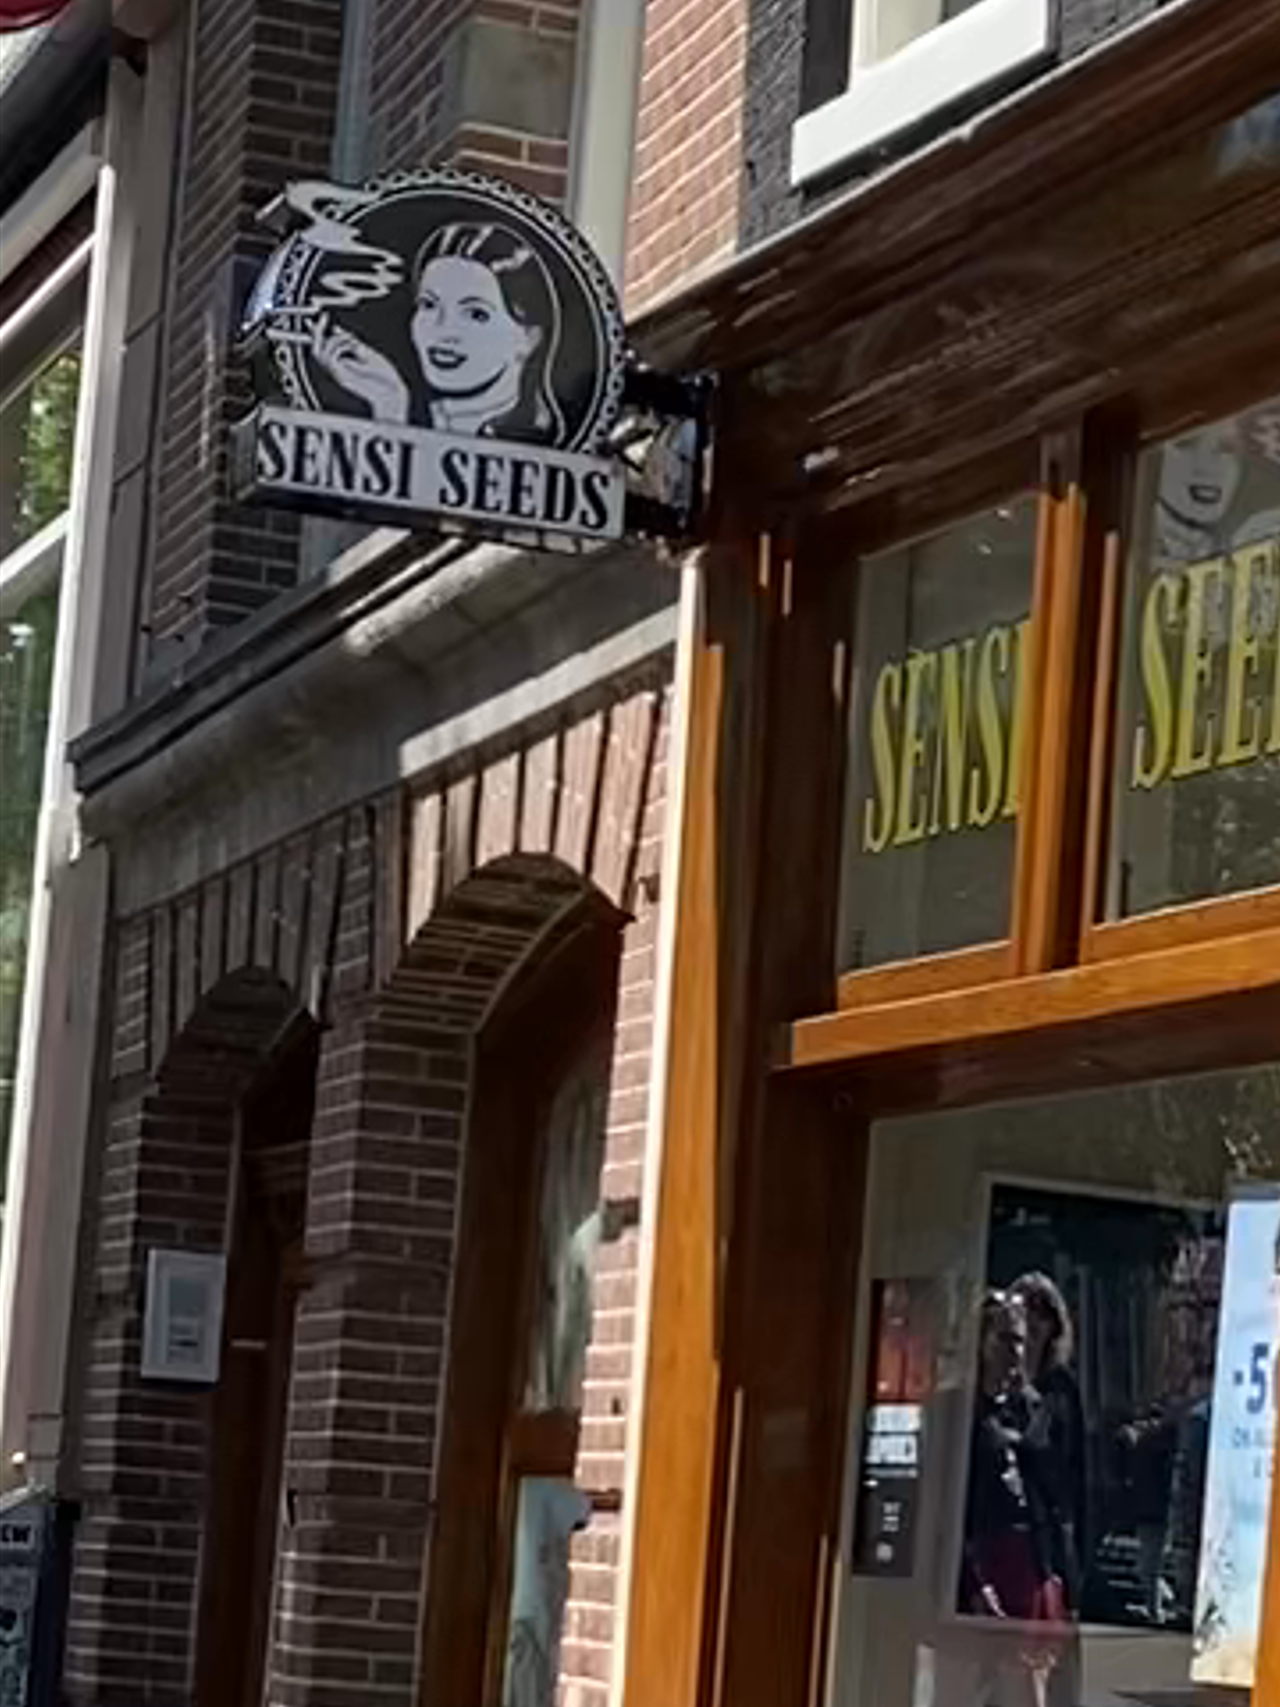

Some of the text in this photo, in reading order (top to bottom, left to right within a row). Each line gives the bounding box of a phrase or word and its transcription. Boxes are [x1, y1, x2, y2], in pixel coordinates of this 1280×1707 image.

[258, 419, 613, 531] SENSI SEEDS
[863, 620, 1027, 853] SENSI
